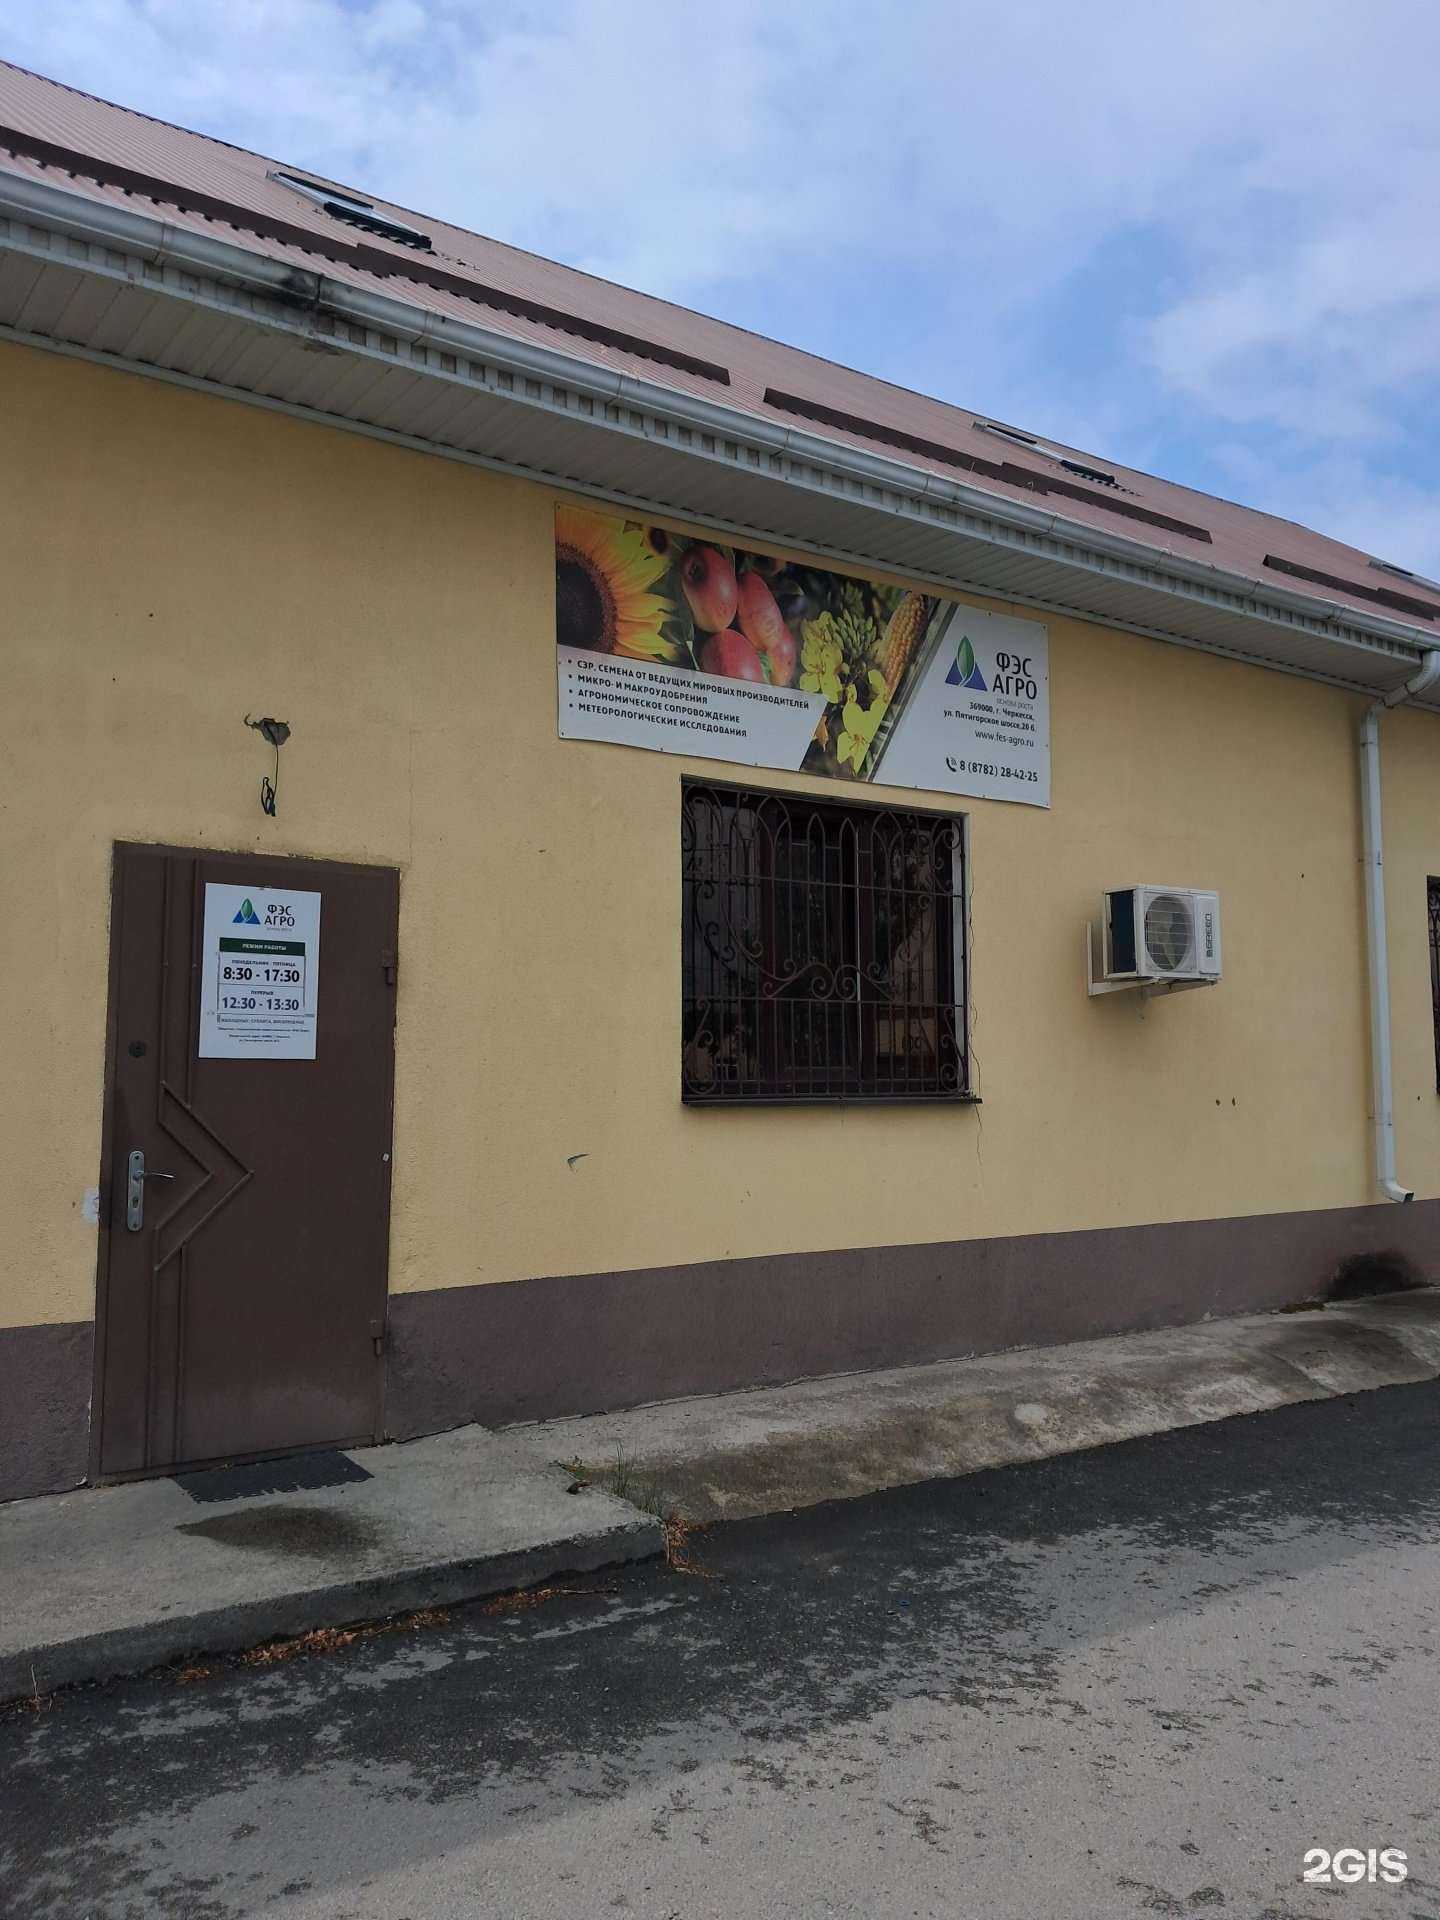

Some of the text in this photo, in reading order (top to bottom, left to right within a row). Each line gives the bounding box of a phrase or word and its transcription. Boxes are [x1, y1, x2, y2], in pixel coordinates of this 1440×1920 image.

[996, 652, 1032, 678] ФЭС
[577, 674, 708, 704] МИКРО- И МАКРОУДОБРЕНИЯ
[598, 664, 634, 678] СЕМЕНА
[635, 671, 647, 680] ОТ
[648, 673, 691, 689] ВЕДУЩИХ
[693, 681, 735, 696] МИРОВЫХ
[736, 690, 809, 709] ПРОИЗВОДИТЕЛЕЙ
[992, 674, 1038, 700] АГРО
[578, 689, 740, 723] АГРОНОМИЧЕСКОЕ СОПРОВОЖДЕНИЕ
[578, 703, 747, 738] МЕТЕОРОЛОГИЧЕСКИЕ ИССЛЕДОВАНИЯ
[955, 711, 999, 725] Пятигорское
[975, 730, 1034, 747] www.fes-agro.ru
[959, 760, 1038, 782] 8 (8782) 28-42-25
[264, 914, 295, 927] АГРО
[267, 904, 293, 916] ФЭС
[223, 966, 253, 981] 8:30
[264, 968, 300, 983] 17:30
[222, 997, 256, 1010] 12:30
[266, 998, 299, 1011] 13:30
